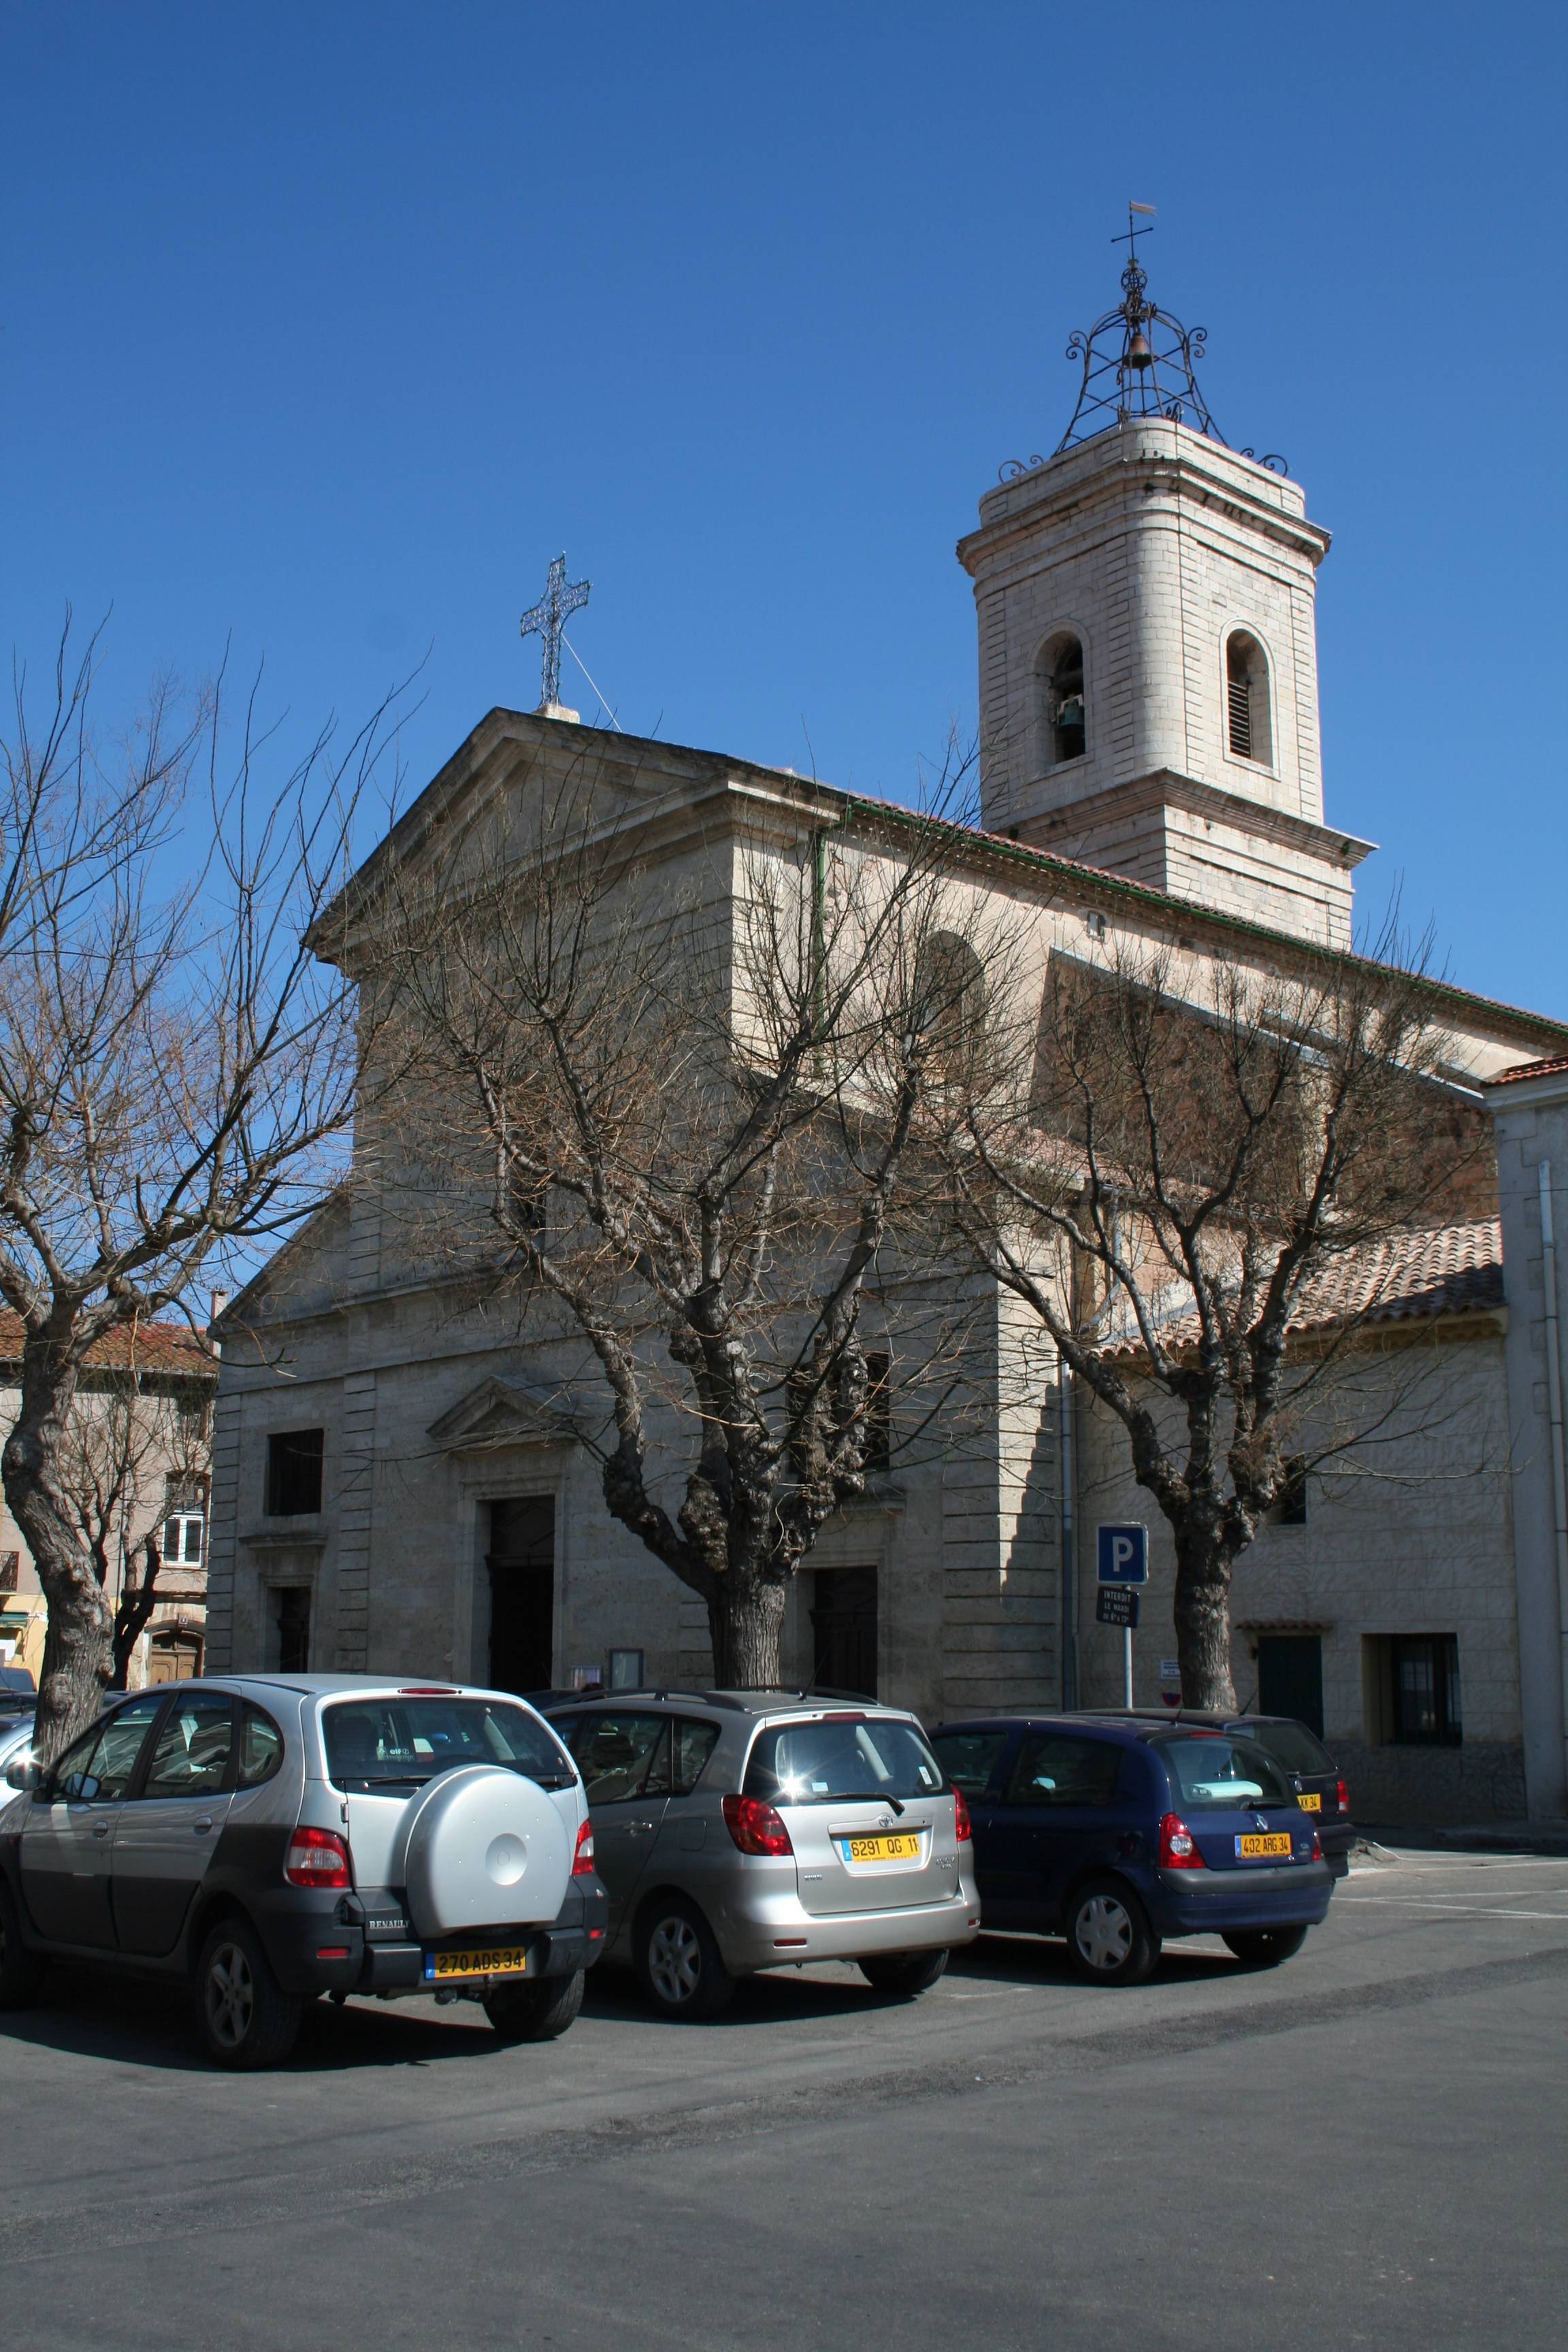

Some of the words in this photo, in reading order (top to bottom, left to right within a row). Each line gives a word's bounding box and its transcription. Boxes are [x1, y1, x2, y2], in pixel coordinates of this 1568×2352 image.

[1112, 1535, 1133, 1572] P
[1103, 1589, 1131, 1603] INTERDIT
[1105, 1601, 1111, 1611] LE
[1113, 1603, 1130, 1613] MARDI
[1309, 1795, 1317, 1808] 34
[851, 1840, 881, 1857] 6291
[887, 1838, 902, 1855] QG
[908, 1837, 918, 1852] 11
[1243, 1838, 1260, 1853] 402
[1263, 1837, 1277, 1852] ARG
[1279, 1837, 1288, 1851] 34
[370, 1920, 410, 1929] RENAULT
[439, 1955, 469, 1973] 270
[472, 1951, 501, 1971] ADS
[504, 1950, 522, 1969] 34
